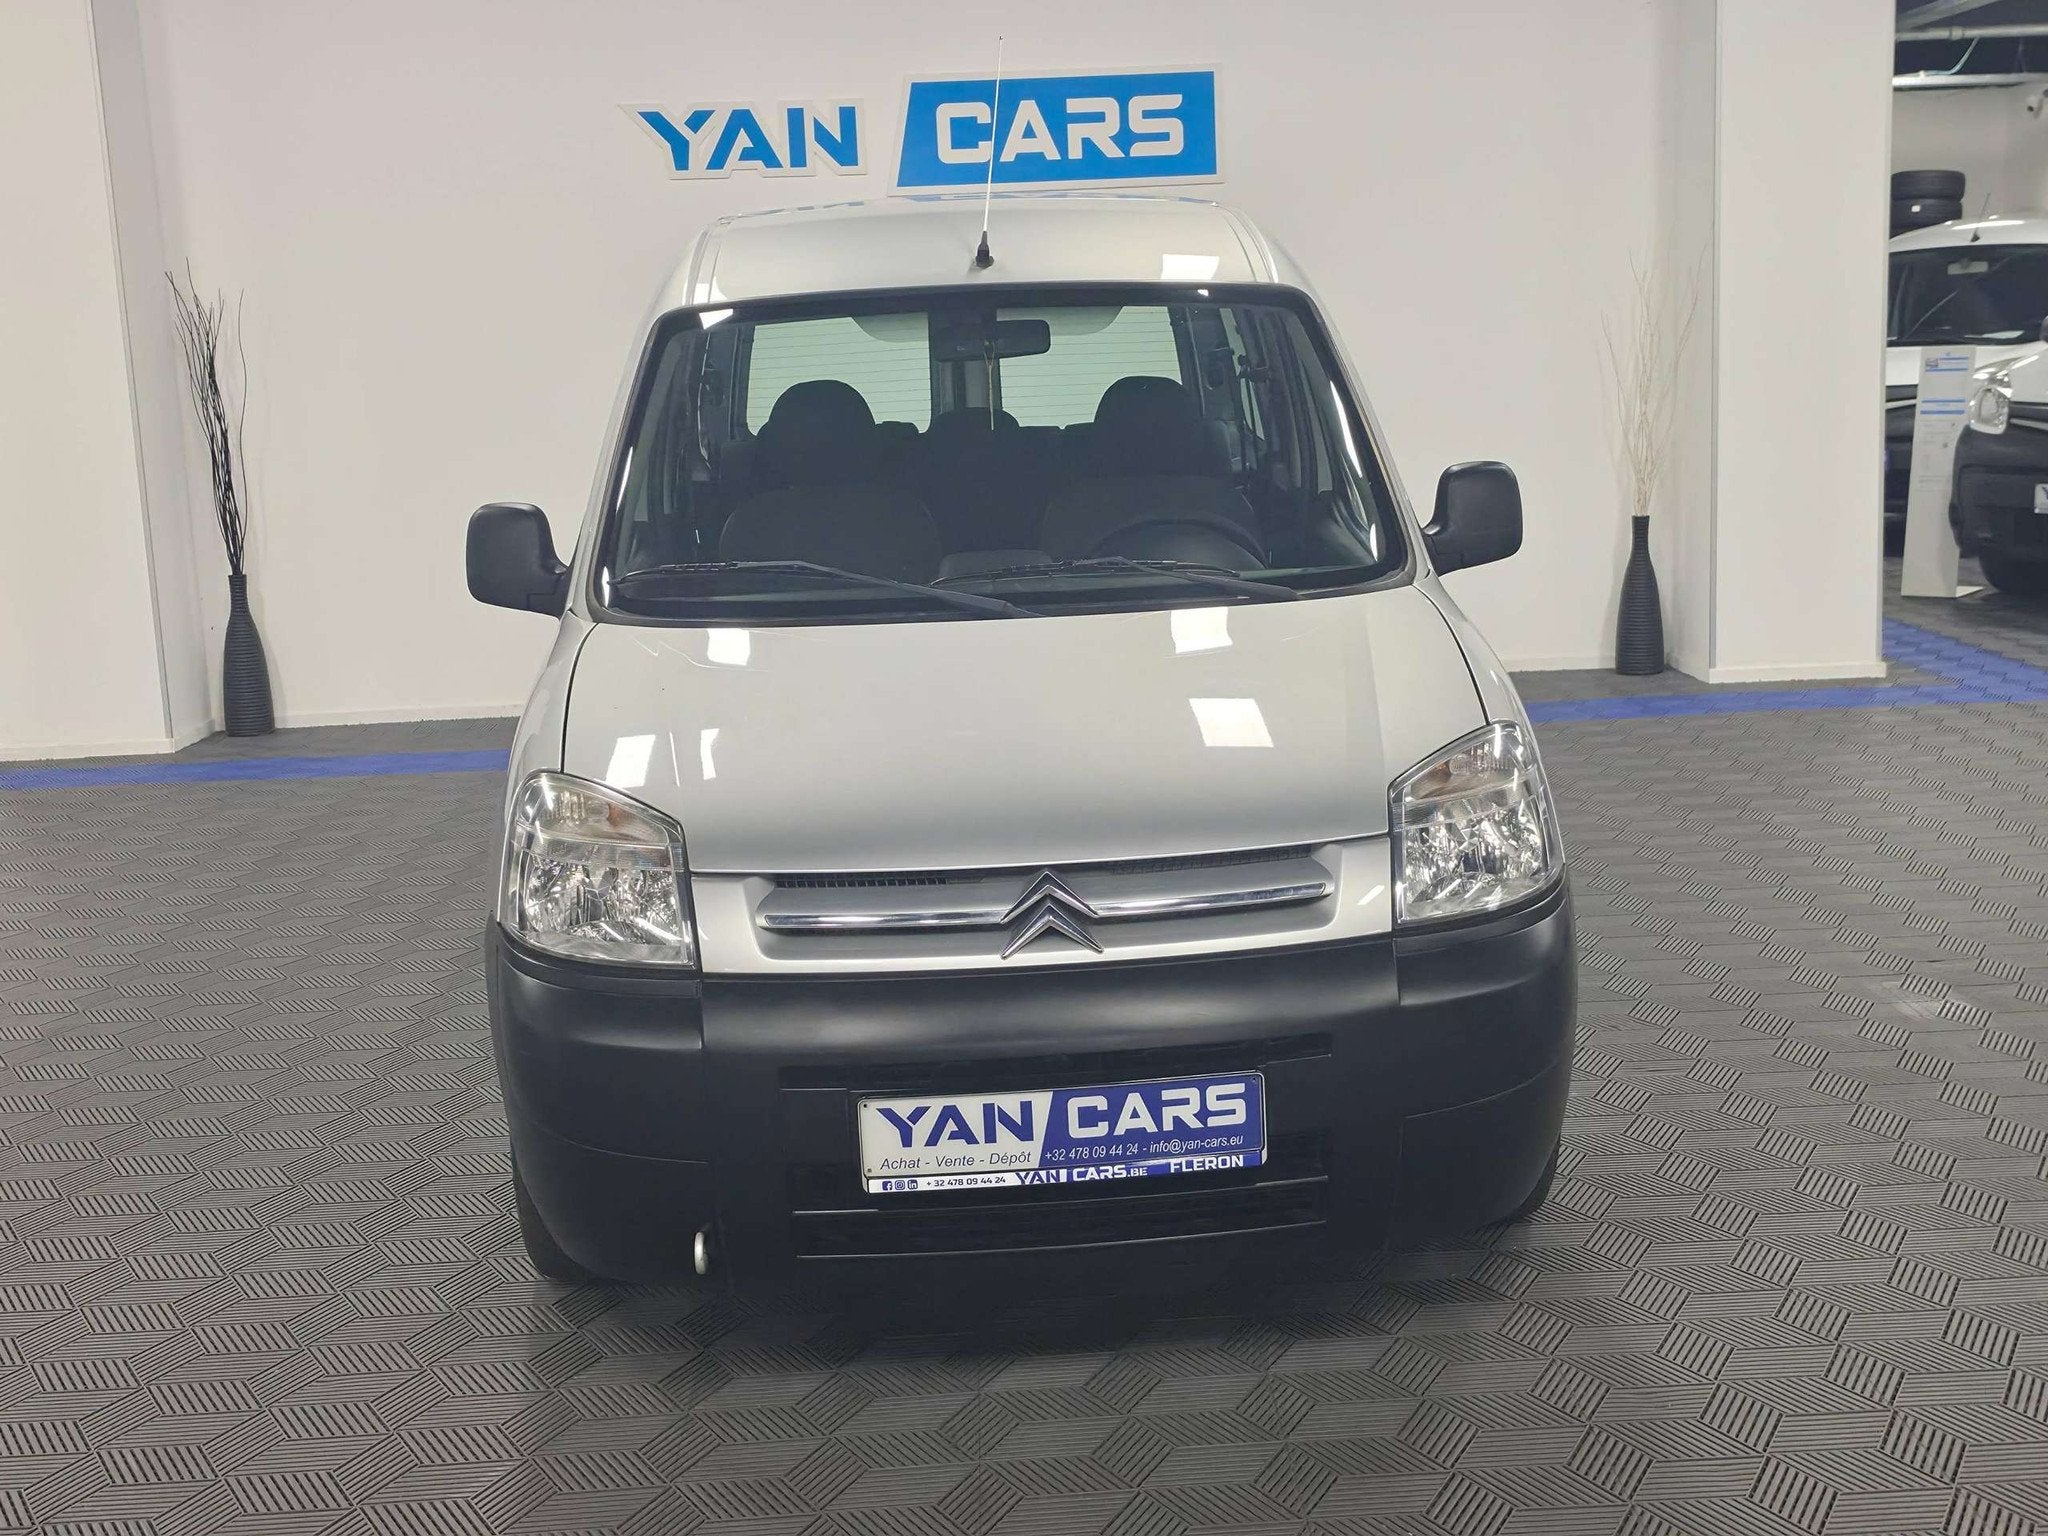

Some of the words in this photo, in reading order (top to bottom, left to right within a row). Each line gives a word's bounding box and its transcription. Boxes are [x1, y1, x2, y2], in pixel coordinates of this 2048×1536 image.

[637, 105, 858, 171] YAN
[936, 94, 1184, 164] CARS
[876, 1100, 1035, 1148] YAN
[1067, 1082, 1247, 1139] CARS
[880, 1157, 921, 1171] Achat
[935, 1154, 975, 1168] Vente
[989, 1151, 1032, 1167] Dépôt
[1045, 1148, 1066, 1161] +32
[1069, 1146, 1090, 1159] 478
[1092, 1145, 1107, 1158] 09
[1109, 1144, 1123, 1157] 44
[1126, 1142, 1139, 1155] 24
[1149, 1135, 1244, 1154] info@yan-cars.eu
[933, 1178, 945, 1187] 32
[947, 1178, 964, 1187] 478
[966, 1177, 978, 1186] 09
[980, 1176, 993, 1185] 44
[994, 1175, 1006, 1184] 24
[1015, 1170, 1061, 1185] YAN
[1170, 1154, 1244, 1173] FLERON
